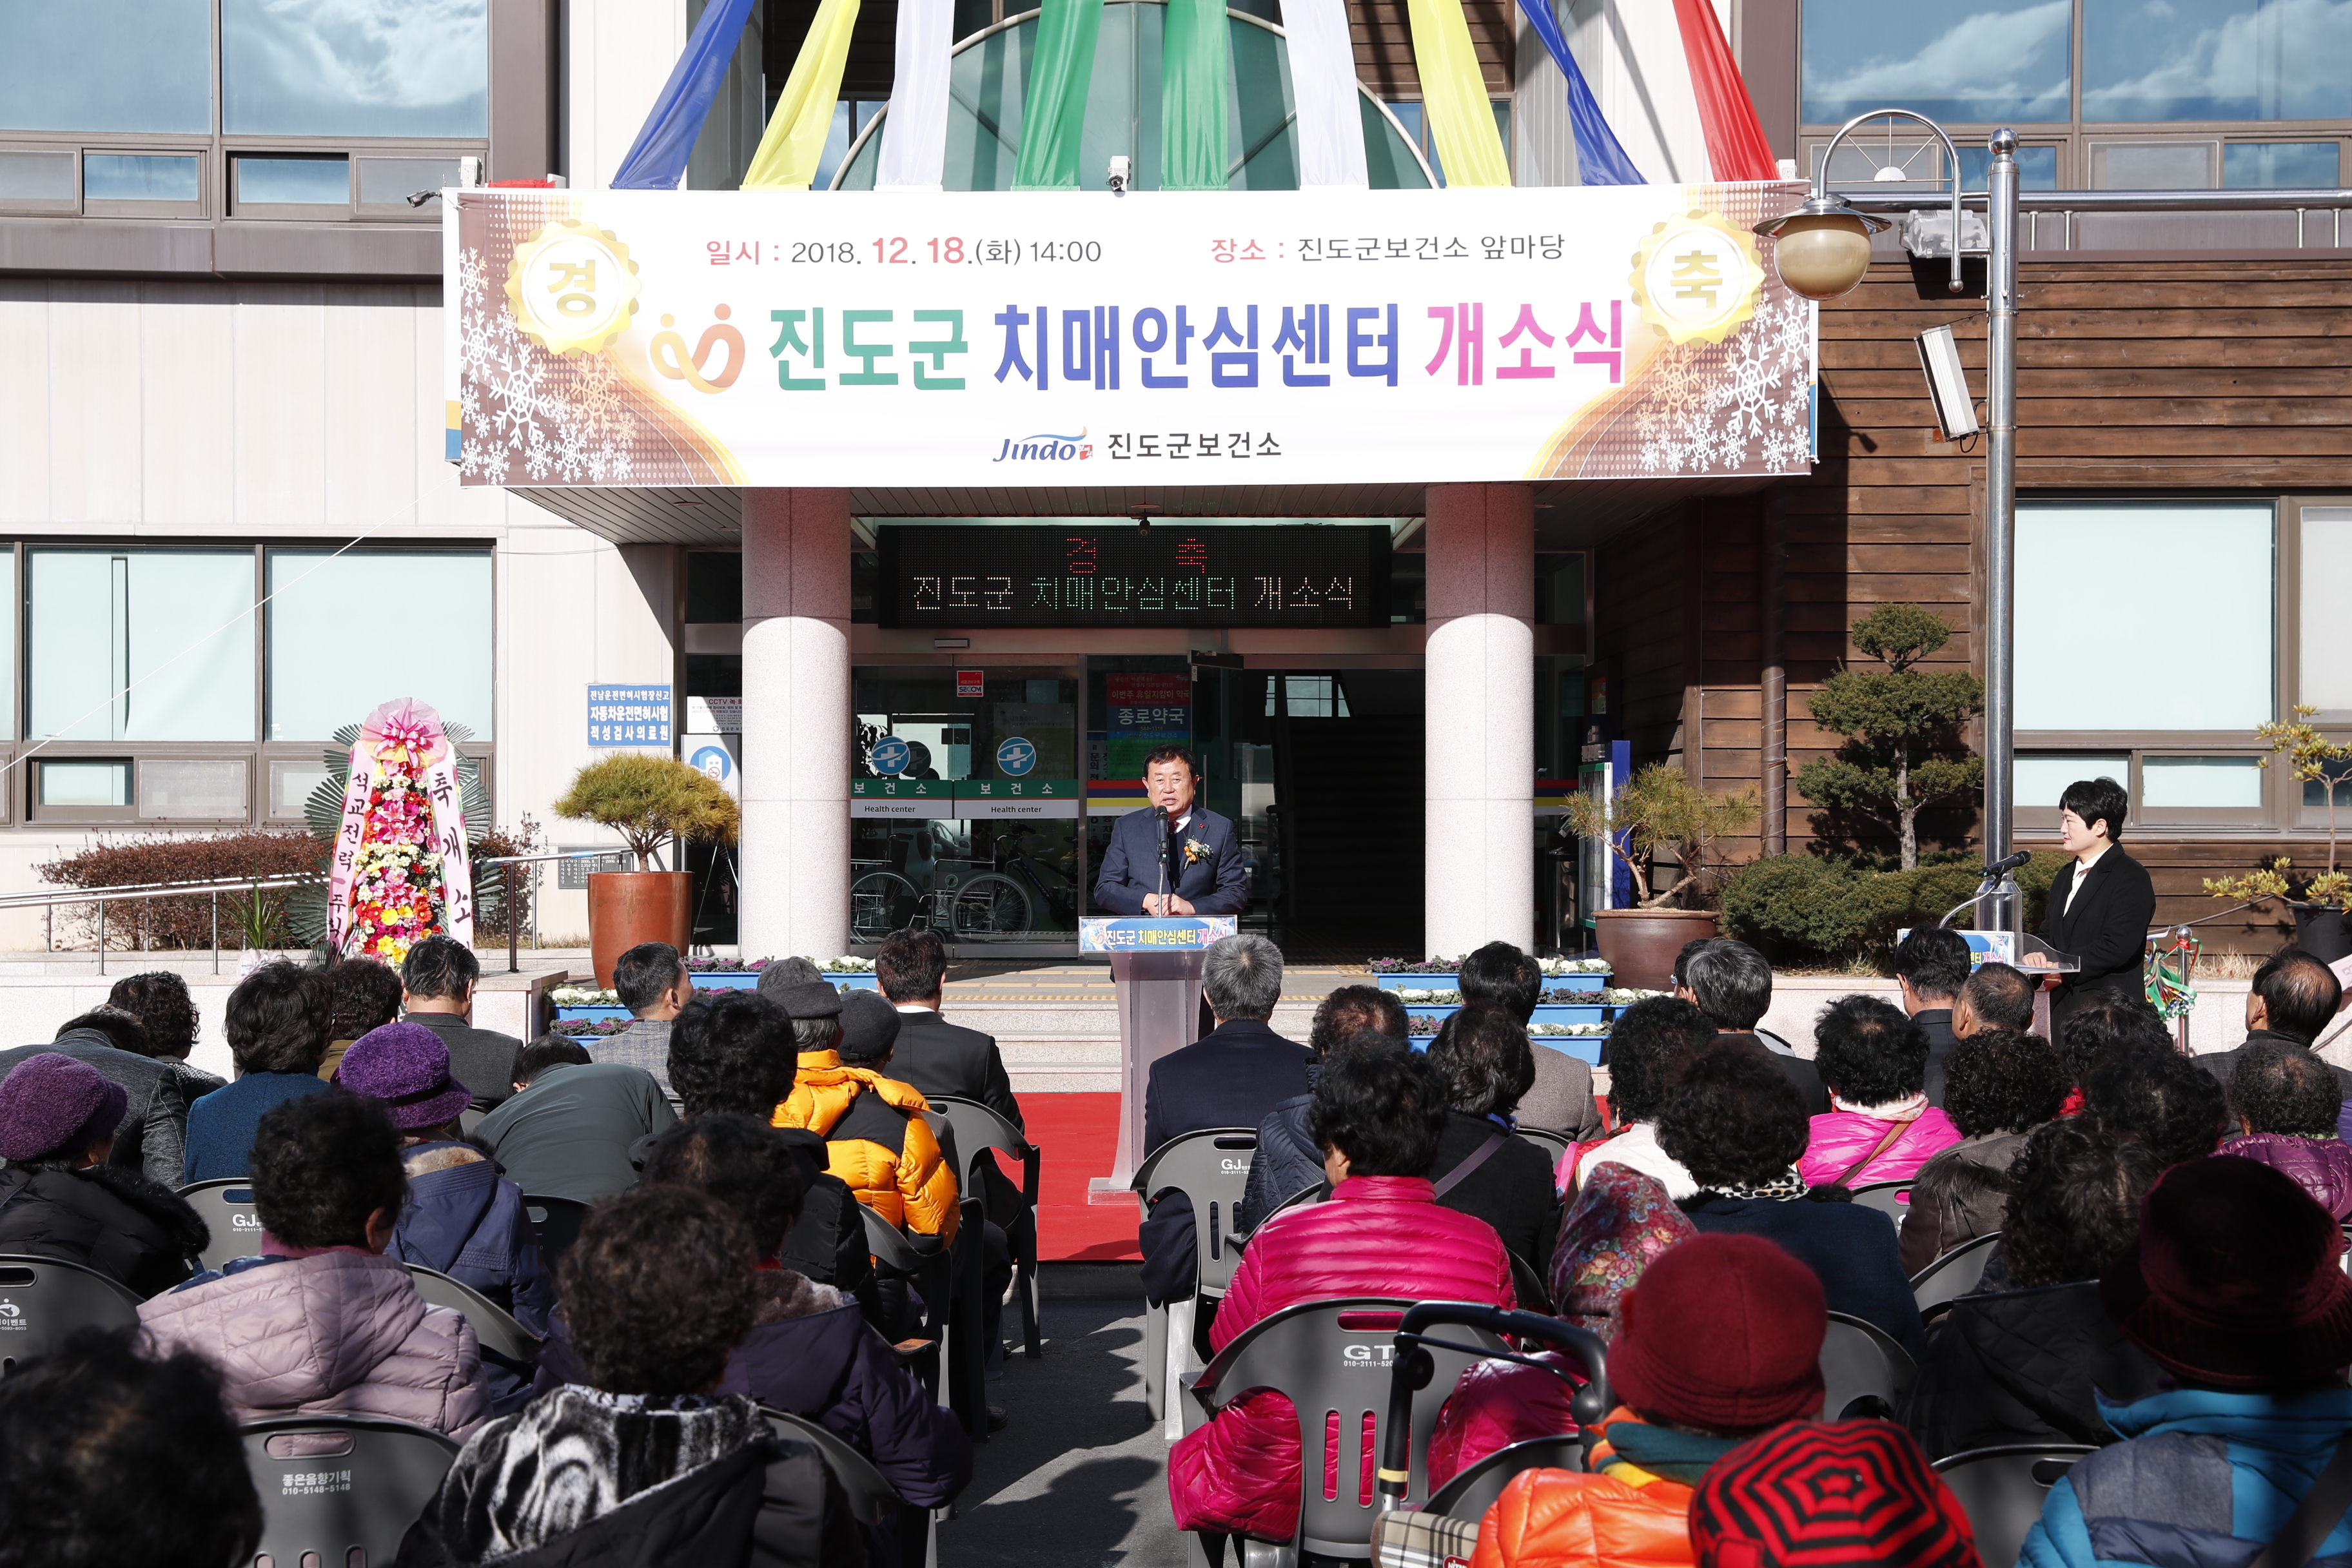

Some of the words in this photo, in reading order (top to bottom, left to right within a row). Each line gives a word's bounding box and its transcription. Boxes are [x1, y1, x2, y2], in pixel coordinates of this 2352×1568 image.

[707, 241, 759, 265] 일시
[792, 242, 861, 265] 2018.
[872, 237, 916, 264] 12.
[1030, 240, 1101, 262] 14:00
[1211, 238, 1266, 263] 장소
[1297, 236, 1469, 262] 진도군보건소
[1480, 233, 1565, 260] 앞마당
[547, 257, 598, 318] 경
[1669, 249, 1723, 309] 축
[769, 307, 968, 391] 진도군
[994, 303, 1398, 391] 치매안심센터
[1424, 299, 1623, 387] 개소식
[992, 438, 1076, 462] Jindo
[1107, 431, 1282, 460] 진도군보건소
[1066, 538, 1096, 574] 경
[1175, 538, 1208, 574] 축
[913, 576, 1014, 610] 진도군
[1031, 576, 1234, 612] 치매안심센터
[1254, 576, 1352, 610] 개소식
[590, 690, 670, 701] 전남운전면허시험장신고
[1112, 691, 1134, 700] 이번주
[1136, 690, 1174, 700] 휴일지킴이
[1176, 690, 1190, 699] 약국
[590, 705, 669, 722] 자동차운전면허시험
[1118, 707, 1185, 725] 종로약국
[1106, 929, 1137, 946] 진도군
[1138, 928, 1197, 946] 치매안심센터
[282, 1469, 351, 1487] 좋은음향기획
[282, 1483, 351, 1495] 010-5148-5148
